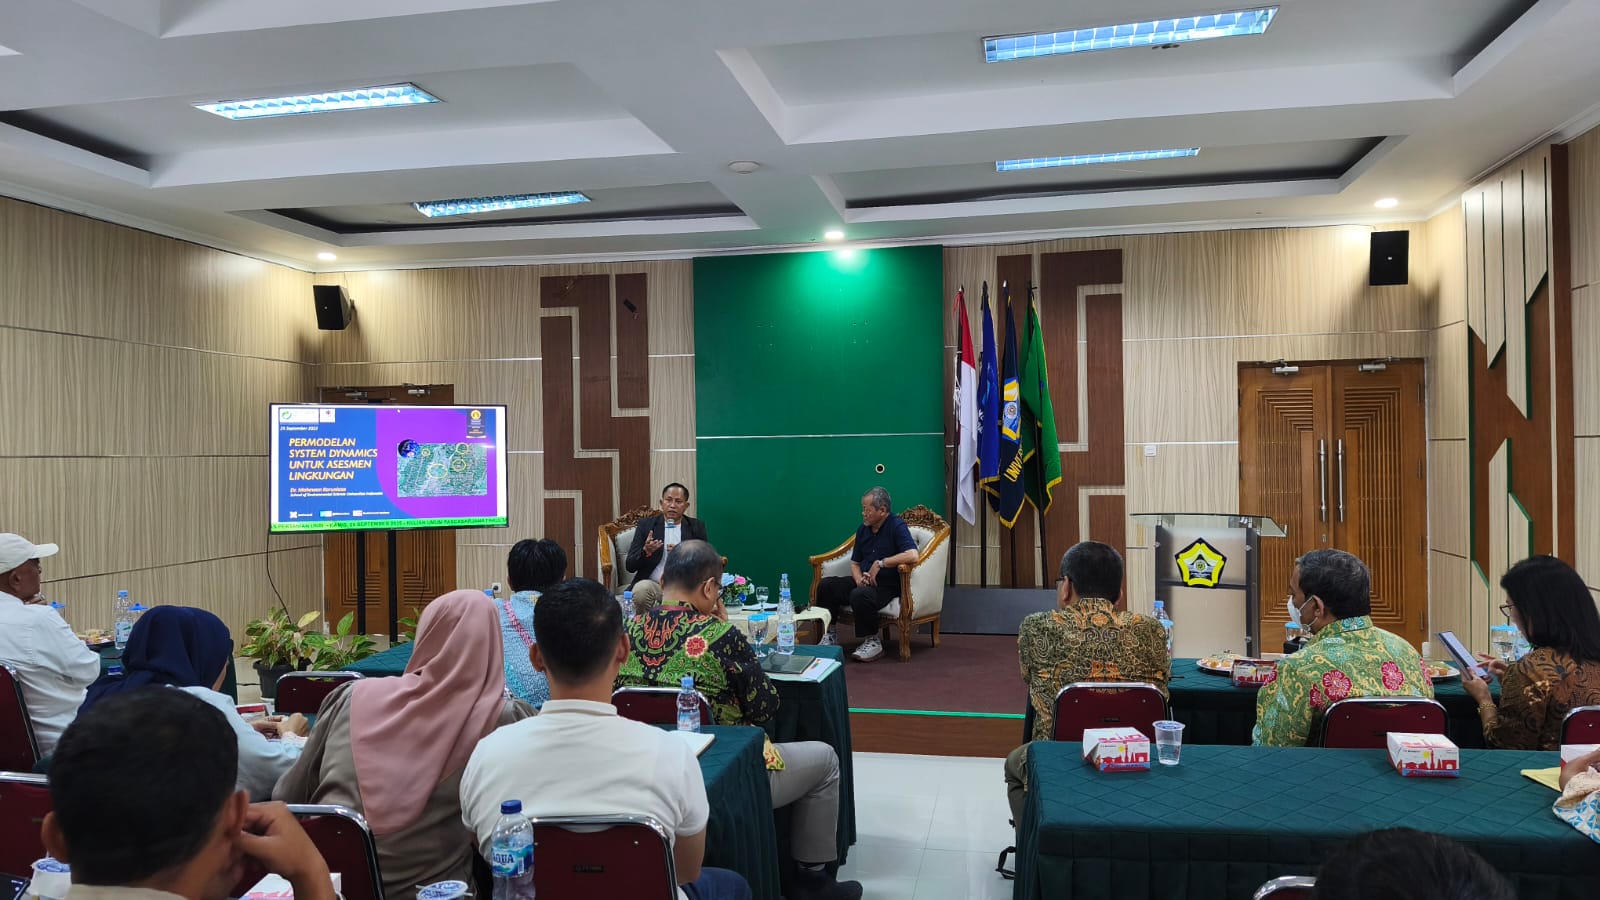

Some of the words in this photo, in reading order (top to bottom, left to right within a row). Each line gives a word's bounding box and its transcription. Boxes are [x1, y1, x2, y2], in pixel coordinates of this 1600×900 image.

[289, 437, 356, 447] PERMODELAN
[289, 449, 326, 458] SYSTEM
[329, 448, 378, 458] DYNAMICS
[289, 460, 324, 469] UNTUK
[326, 459, 372, 469] ASESMEN
[289, 471, 355, 481] LINGKUNGAN
